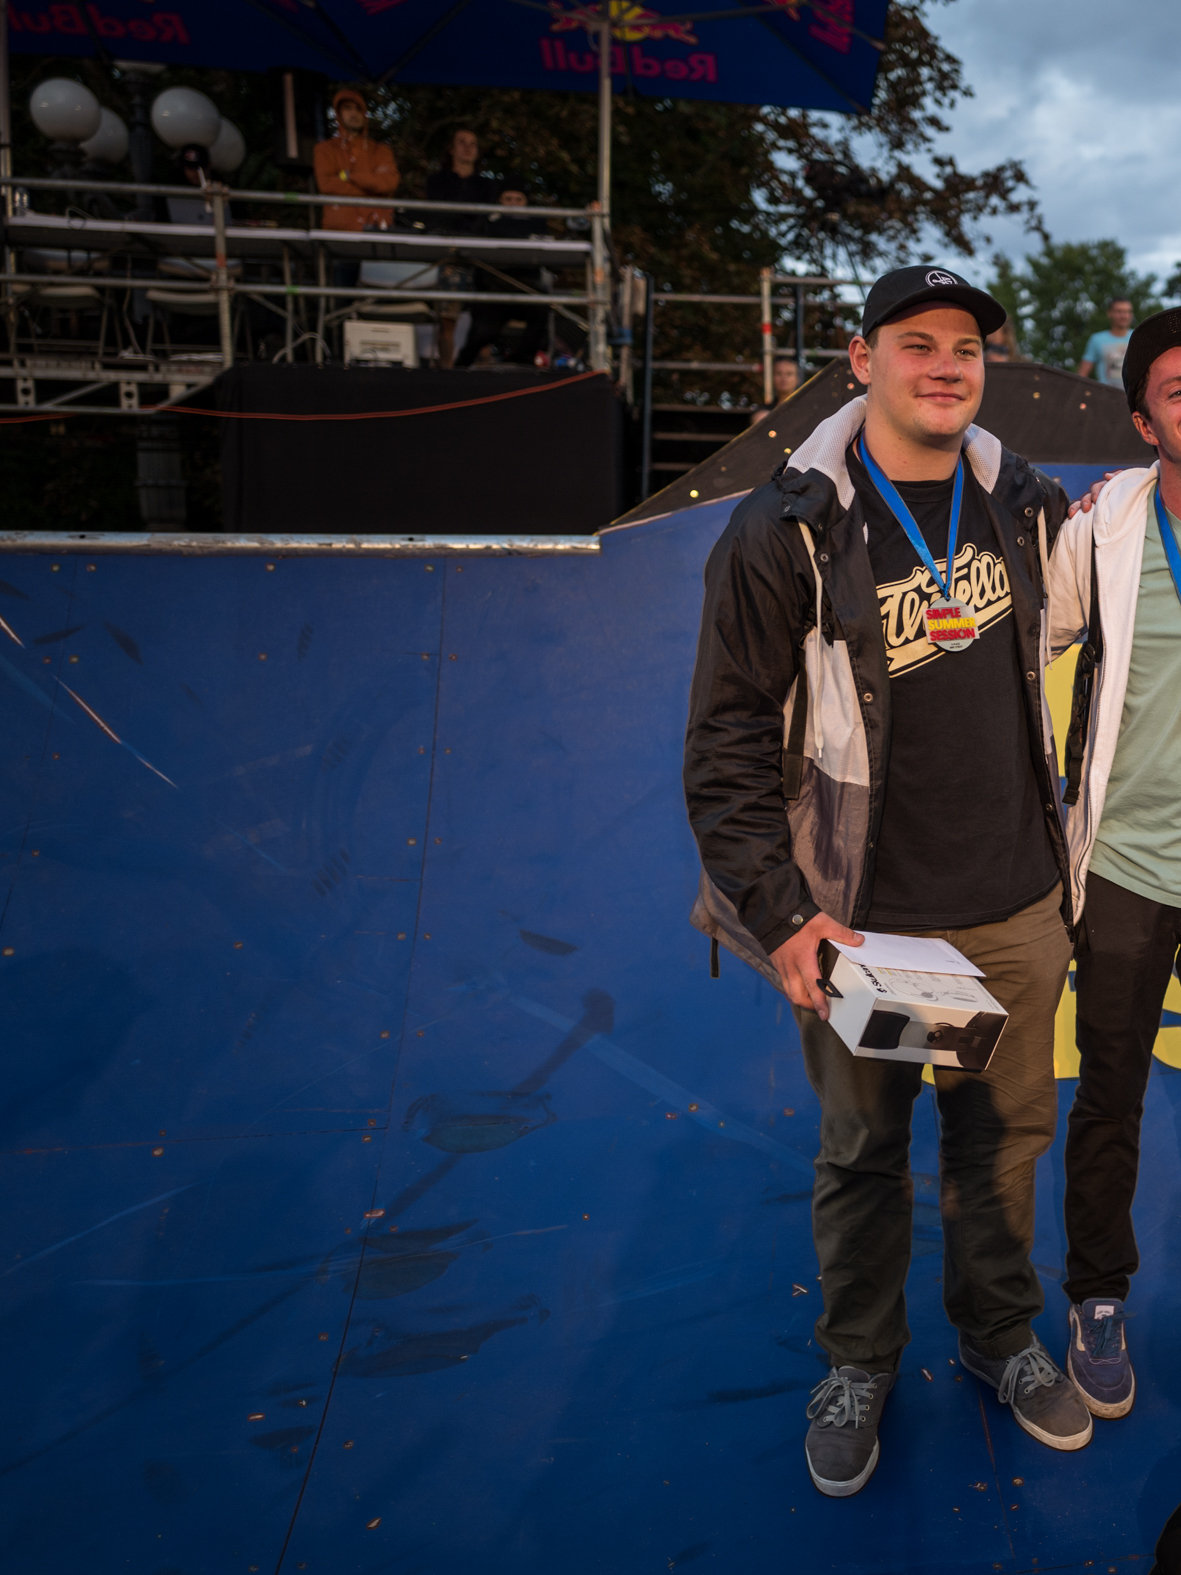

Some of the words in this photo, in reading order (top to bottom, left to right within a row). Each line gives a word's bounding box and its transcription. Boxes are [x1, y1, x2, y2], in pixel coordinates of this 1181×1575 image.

[925, 607, 961, 620] SIMPLE
[927, 617, 976, 631] SUMMER
[930, 628, 975, 641] SESSION
